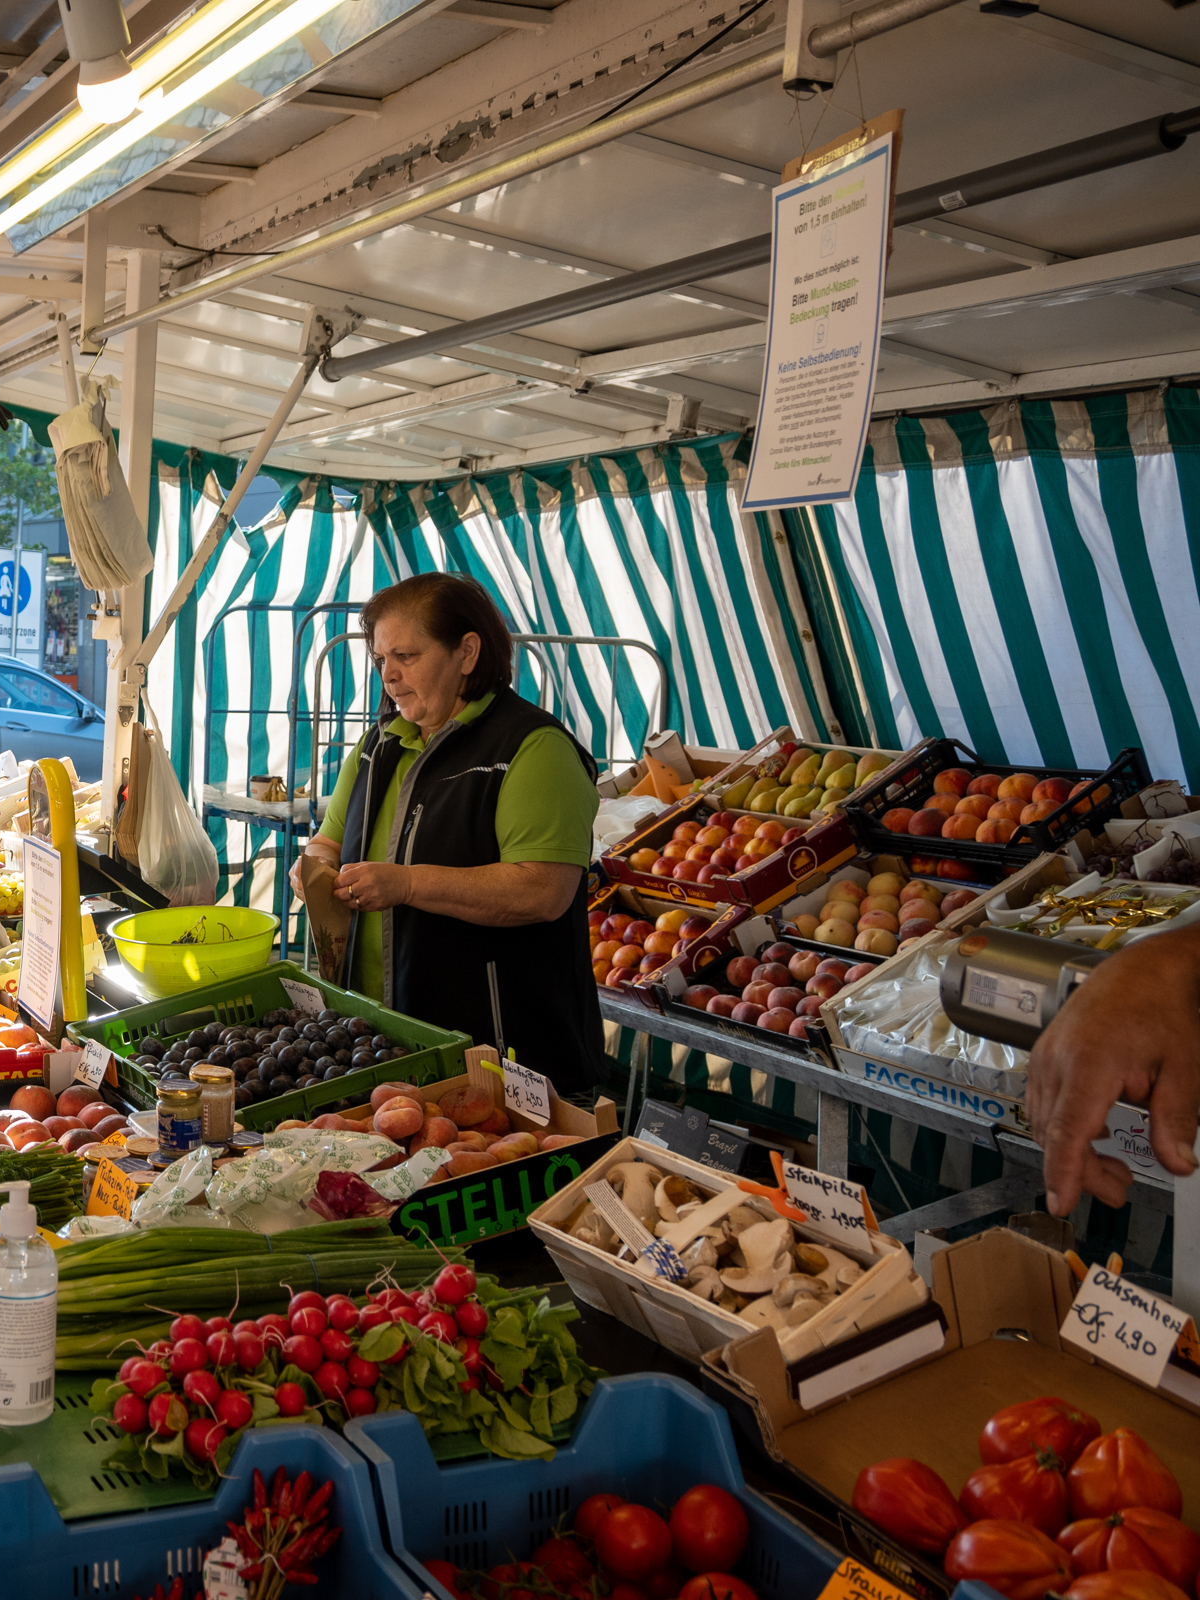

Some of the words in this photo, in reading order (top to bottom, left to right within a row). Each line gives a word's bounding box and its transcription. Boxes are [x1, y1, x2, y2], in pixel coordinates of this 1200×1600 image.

[793, 222, 808, 235] von
[810, 214, 821, 230] 1,5
[822, 213, 829, 224] m
[831, 194, 867, 220] einhalten!
[799, 201, 816, 216] Bitte
[818, 194, 832, 208] den
[803, 273, 814, 282] dies
[815, 268, 828, 279] nicht
[829, 259, 850, 273] möglich
[792, 293, 808, 307] Bitte
[810, 277, 859, 300] Mund-Nasen-
[789, 304, 830, 325] Bedeckung
[831, 292, 858, 312] tragen!
[778, 361, 797, 374] Keine
[798, 341, 862, 369] Selbstbedienung!
[774, 461, 790, 470] Danke
[864, 1061, 1005, 1119] FACCHINO
[708, 1133, 738, 1154] Brazil
[1115, 1321, 1157, 1356] 4,90
